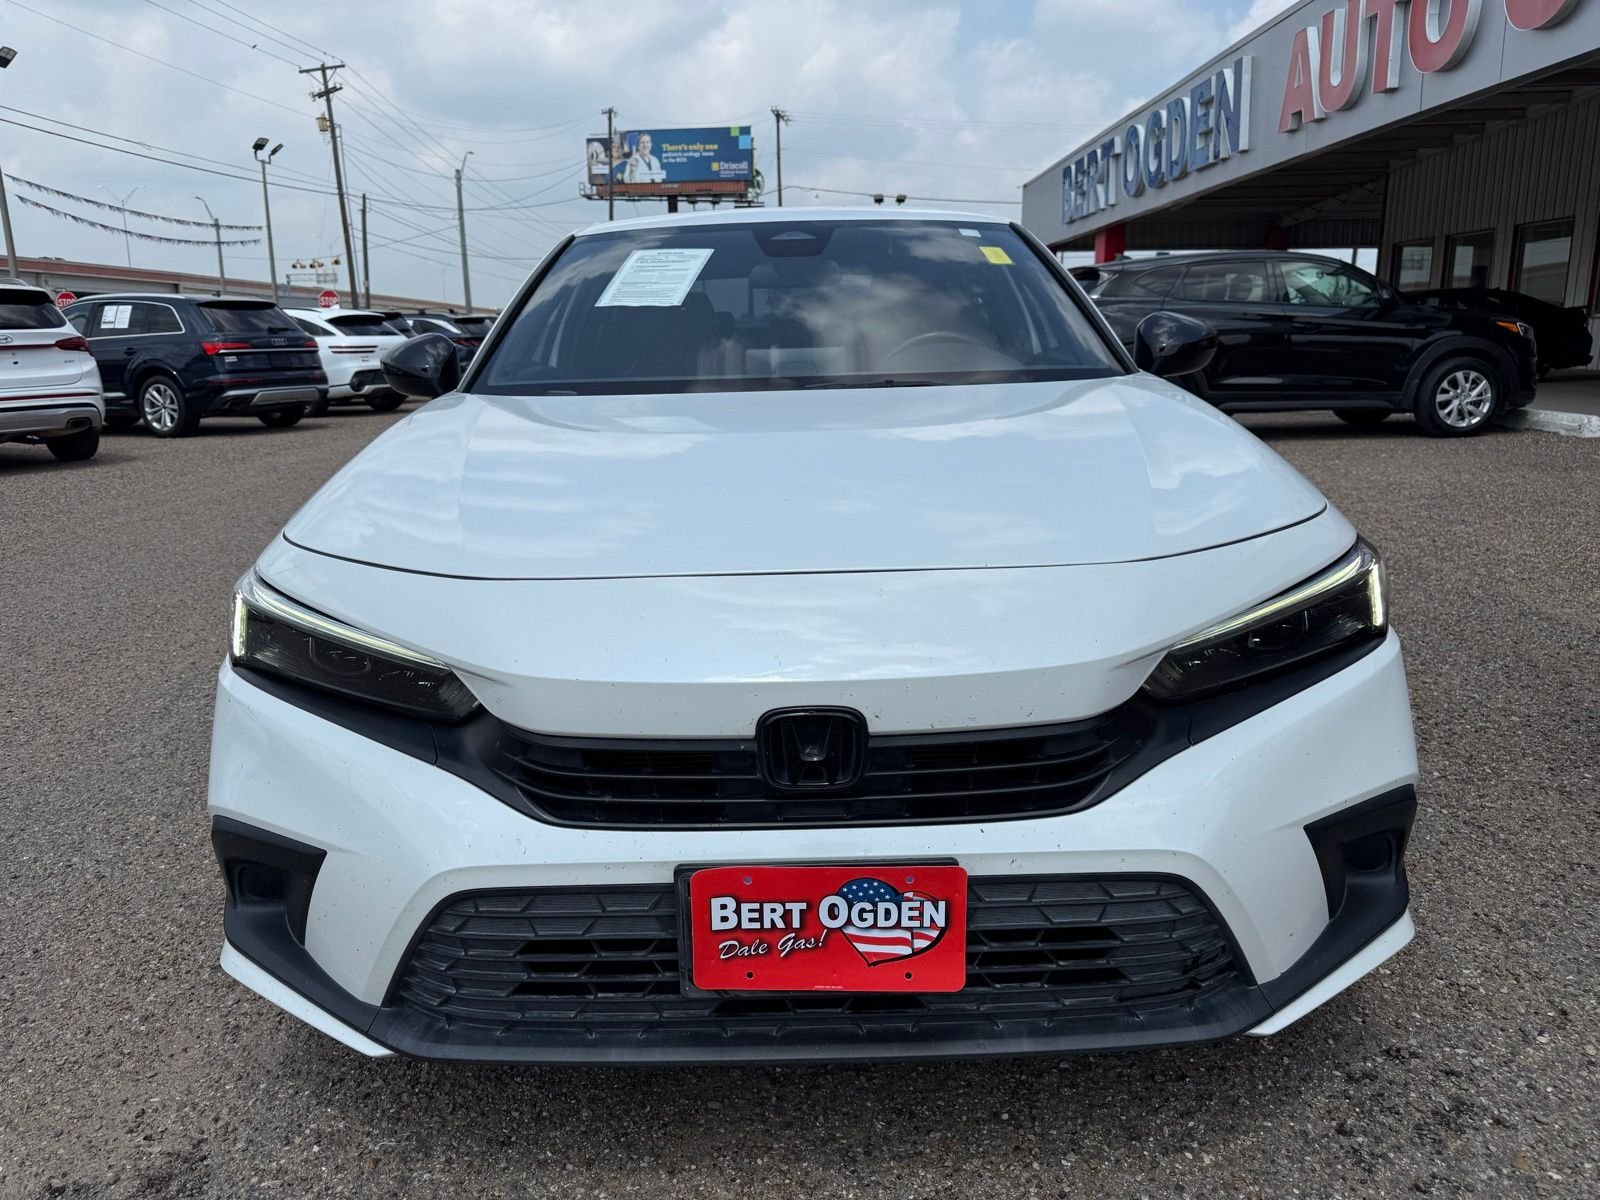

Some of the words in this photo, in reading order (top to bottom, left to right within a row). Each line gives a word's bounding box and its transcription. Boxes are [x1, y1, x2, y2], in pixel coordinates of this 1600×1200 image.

[1062, 135, 1121, 224] BERT
[1122, 56, 1252, 198] OGDEN
[1278, 0, 1482, 133] AUTO
[720, 161, 748, 170] Driscoll
[320, 296, 337, 306] STOP
[710, 895, 807, 931] BERT
[818, 895, 946, 929] OGDEN
[719, 938, 769, 960] Dale
[777, 928, 828, 958] Gas!
